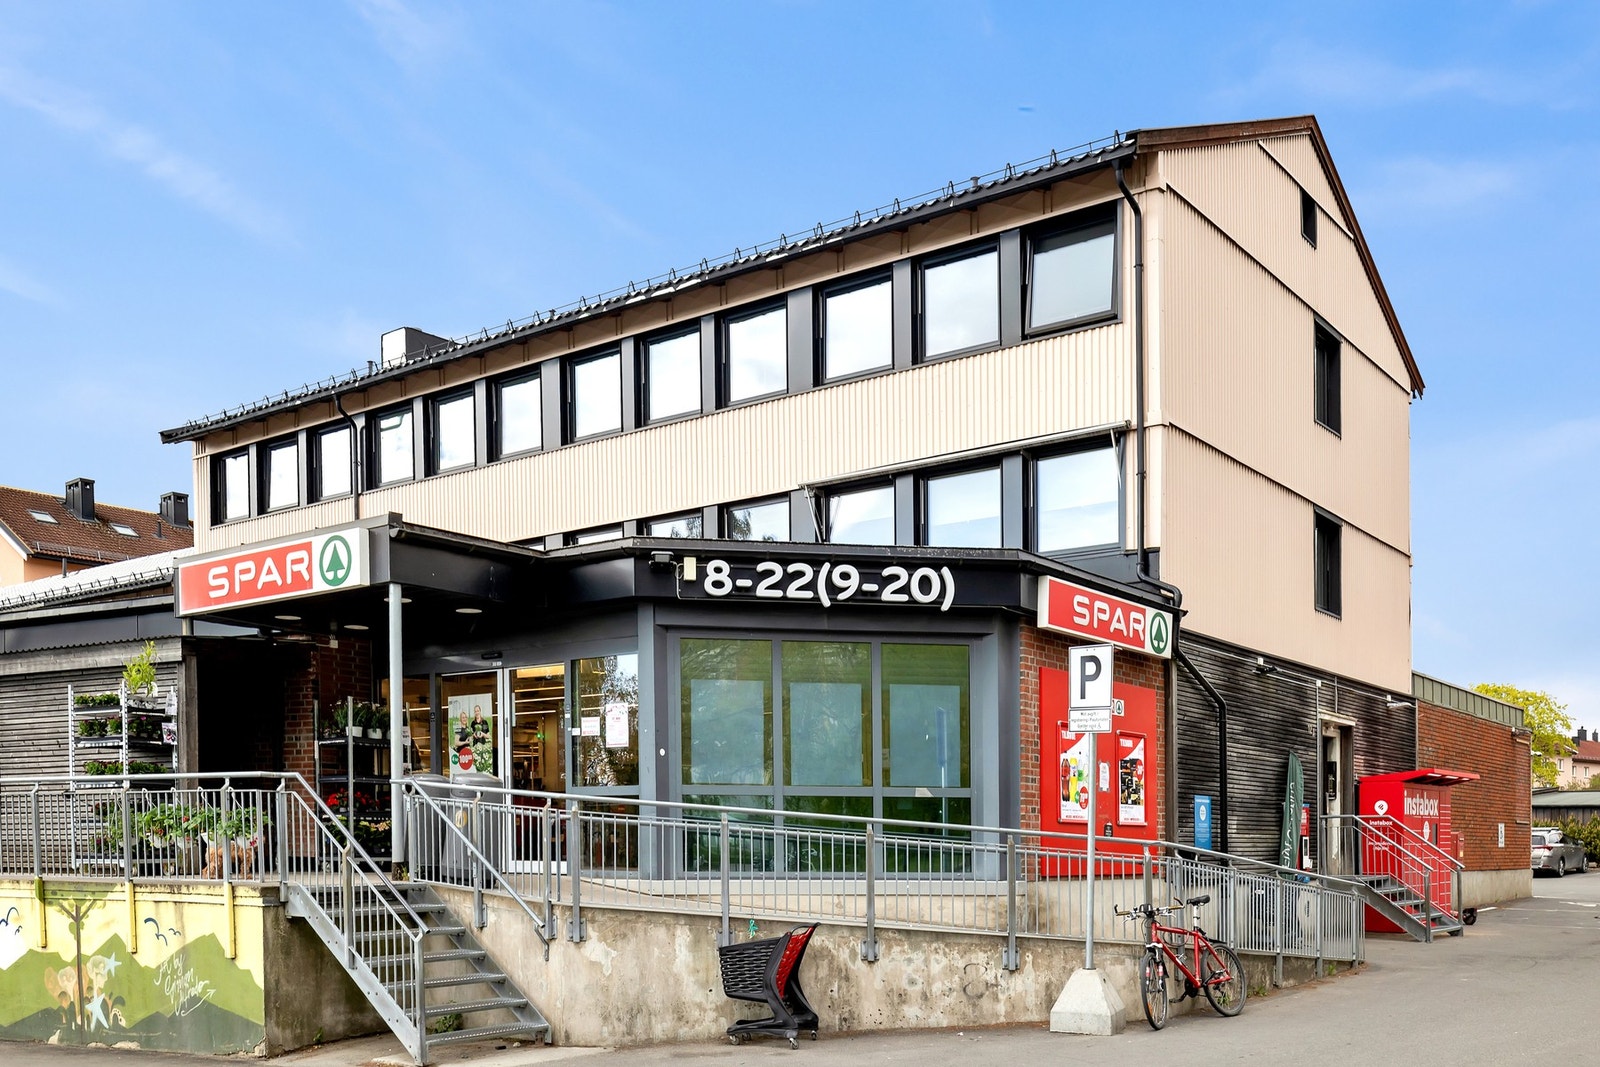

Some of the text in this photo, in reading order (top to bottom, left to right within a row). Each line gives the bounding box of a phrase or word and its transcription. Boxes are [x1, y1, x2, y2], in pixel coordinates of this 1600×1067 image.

[208, 550, 311, 599] SPAR
[703, 559, 955, 612] 8-22(9-20)
[1073, 594, 1145, 641] SPAR
[1080, 655, 1102, 700] P
[1404, 789, 1439, 816] instabox
